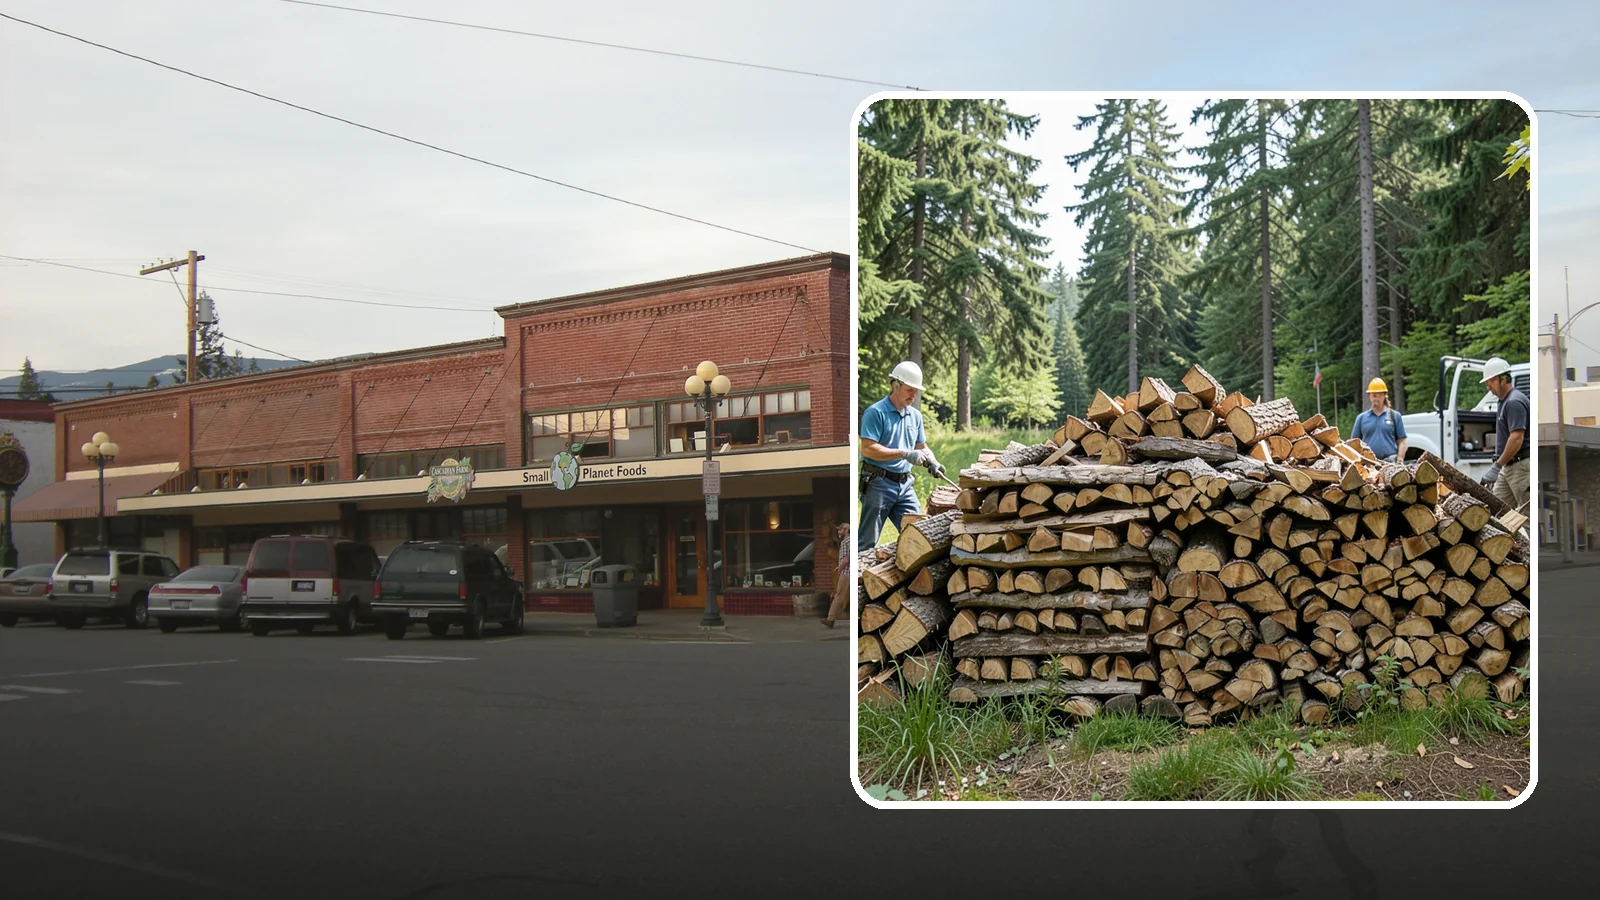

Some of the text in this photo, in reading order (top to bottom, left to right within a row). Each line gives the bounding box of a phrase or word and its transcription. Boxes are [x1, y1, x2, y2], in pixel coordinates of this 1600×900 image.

[523, 463, 647, 483] Small Planet Foods
